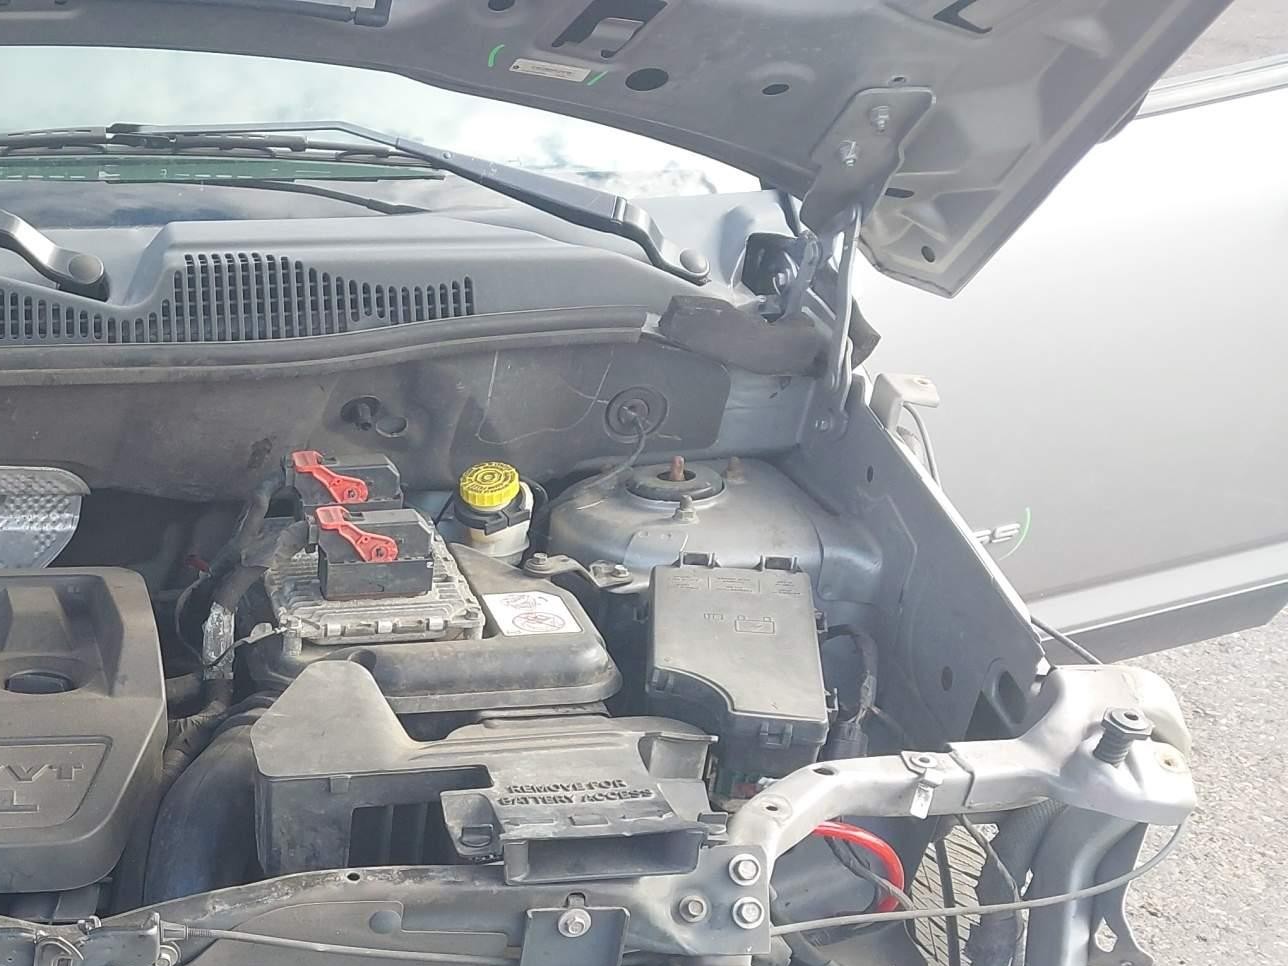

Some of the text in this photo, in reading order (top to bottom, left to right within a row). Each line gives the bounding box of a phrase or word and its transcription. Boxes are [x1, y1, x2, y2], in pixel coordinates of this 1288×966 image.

[507, 779, 627, 794] REMOVE FOR
[580, 789, 654, 803] ACCESS
